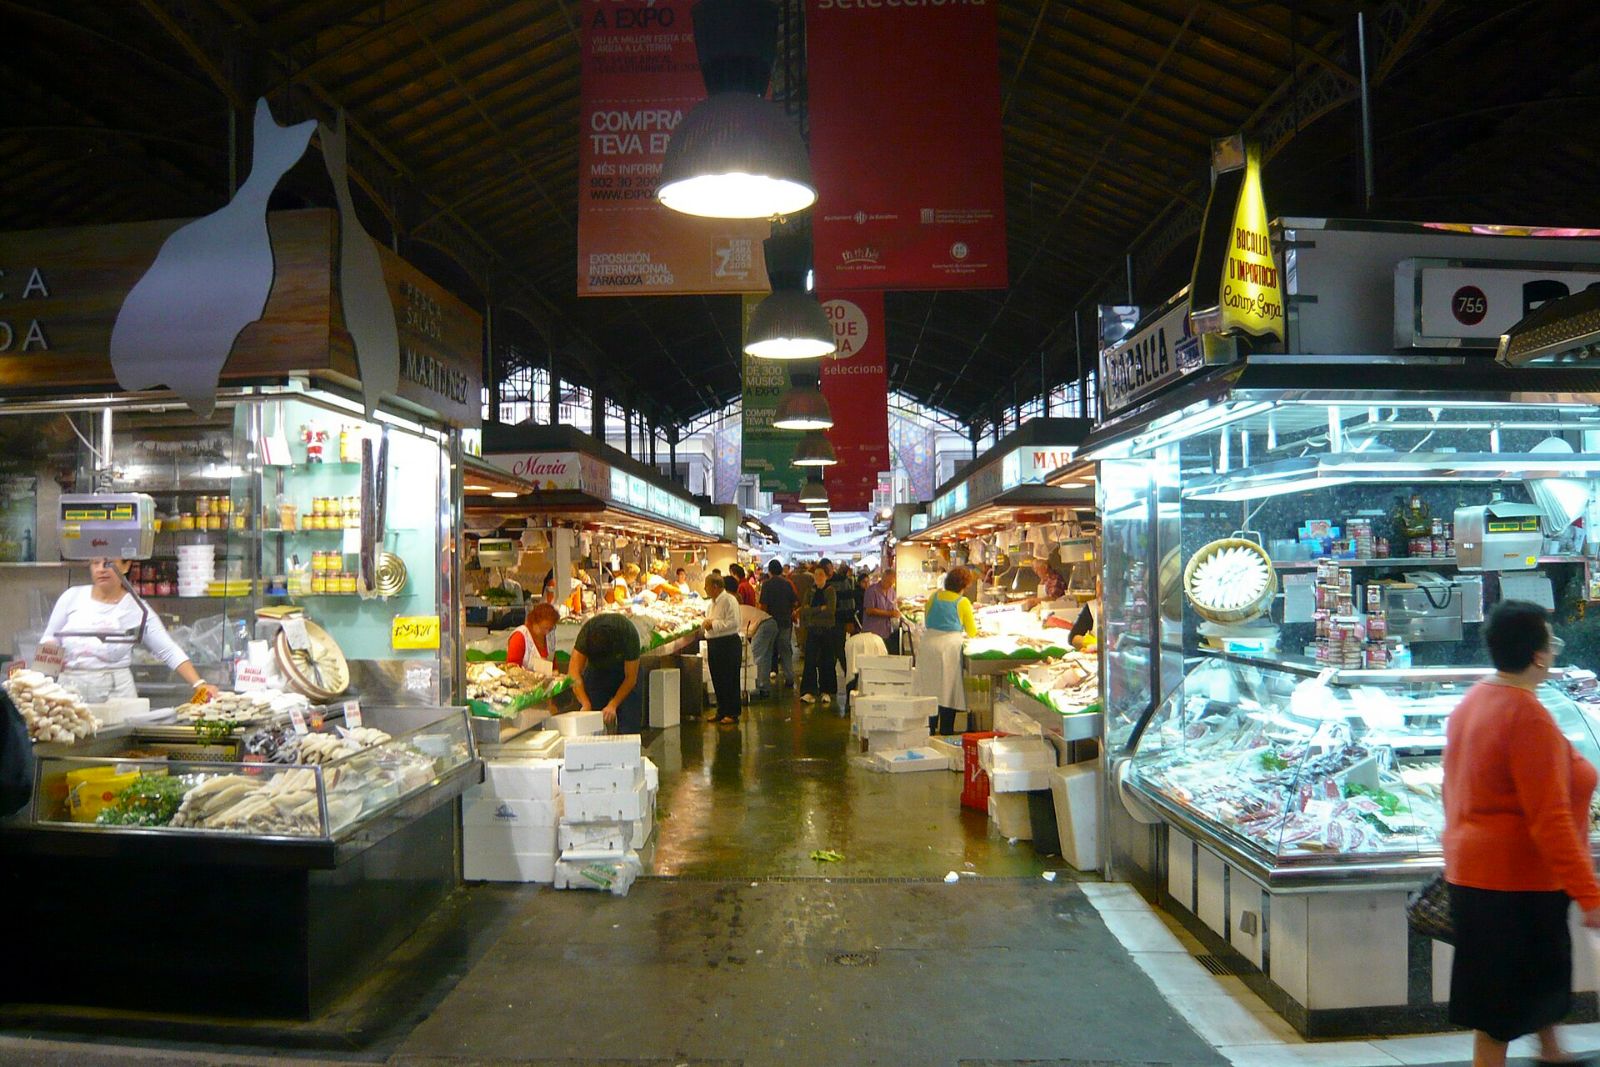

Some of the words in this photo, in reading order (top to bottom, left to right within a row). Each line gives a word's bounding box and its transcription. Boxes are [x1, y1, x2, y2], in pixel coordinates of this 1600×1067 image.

[592, 8, 608, 29] A
[615, 7, 675, 28] EXPO
[590, 133, 644, 155] TEVA
[590, 161, 616, 176] MÉS
[619, 163, 663, 176] INFORM
[590, 177, 613, 188] 902
[636, 177, 662, 187] 200
[589, 250, 651, 264] EXPOSICIÓN
[589, 263, 670, 275] INTERNACIONAL
[589, 274, 643, 286] ZARAGOZA
[645, 273, 674, 286] 2008
[1223, 284, 1256, 315] Carme
[830, 321, 858, 336] UE
[746, 366, 759, 376] DE
[761, 366, 782, 376] 300
[823, 364, 884, 376] selecciona
[755, 387, 780, 396] EXPO
[512, 456, 567, 476] Maria
